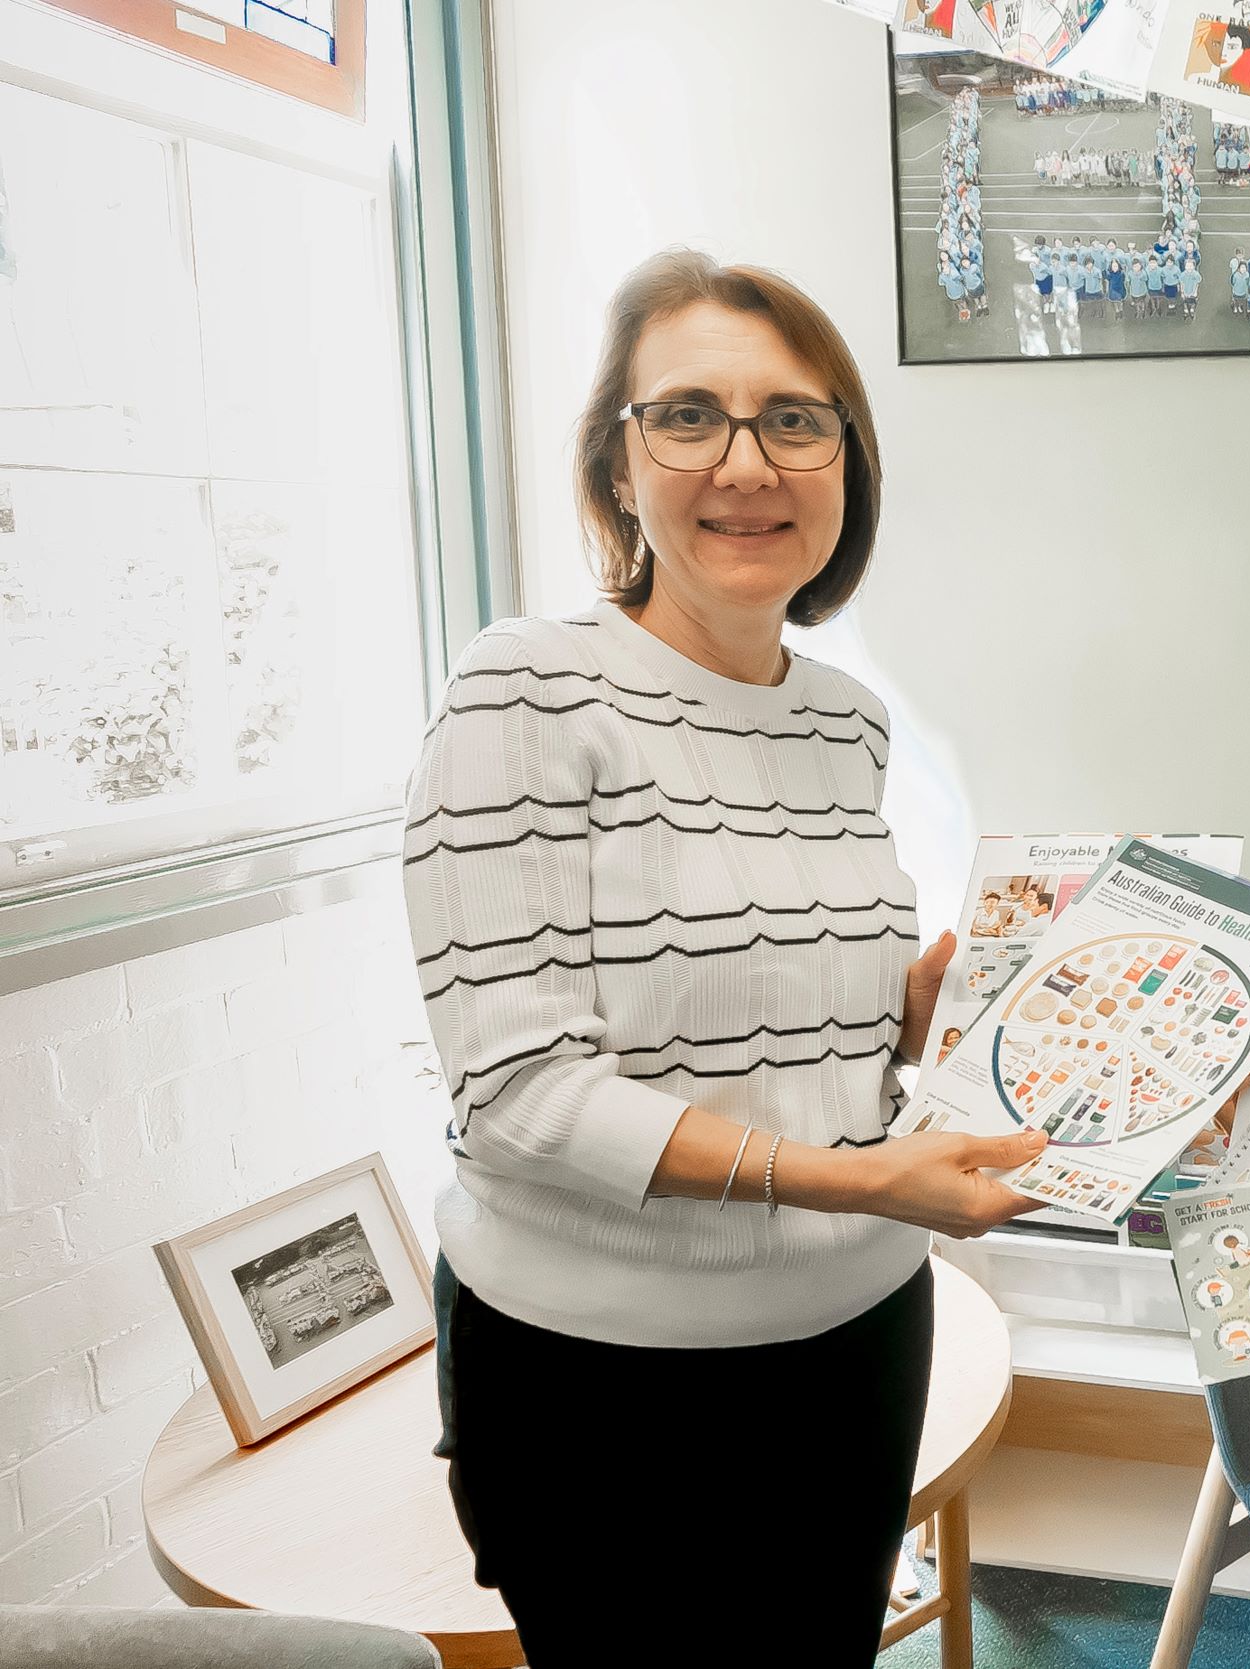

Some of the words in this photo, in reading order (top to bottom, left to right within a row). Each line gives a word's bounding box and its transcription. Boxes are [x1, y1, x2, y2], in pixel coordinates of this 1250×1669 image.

[1199, 12, 1222, 22] ONE
[1197, 76, 1240, 95] HUMAN
[1029, 845, 1100, 861] Enjoyable
[1107, 869, 1172, 907] Australian
[1169, 895, 1206, 921] Guide
[1204, 909, 1220, 927] to
[1175, 1205, 1192, 1217] GET
[1195, 1203, 1202, 1213] A
[1202, 1198, 1232, 1210] FRESH
[1180, 1212, 1208, 1226] START
[1210, 1210, 1228, 1220] FOR
